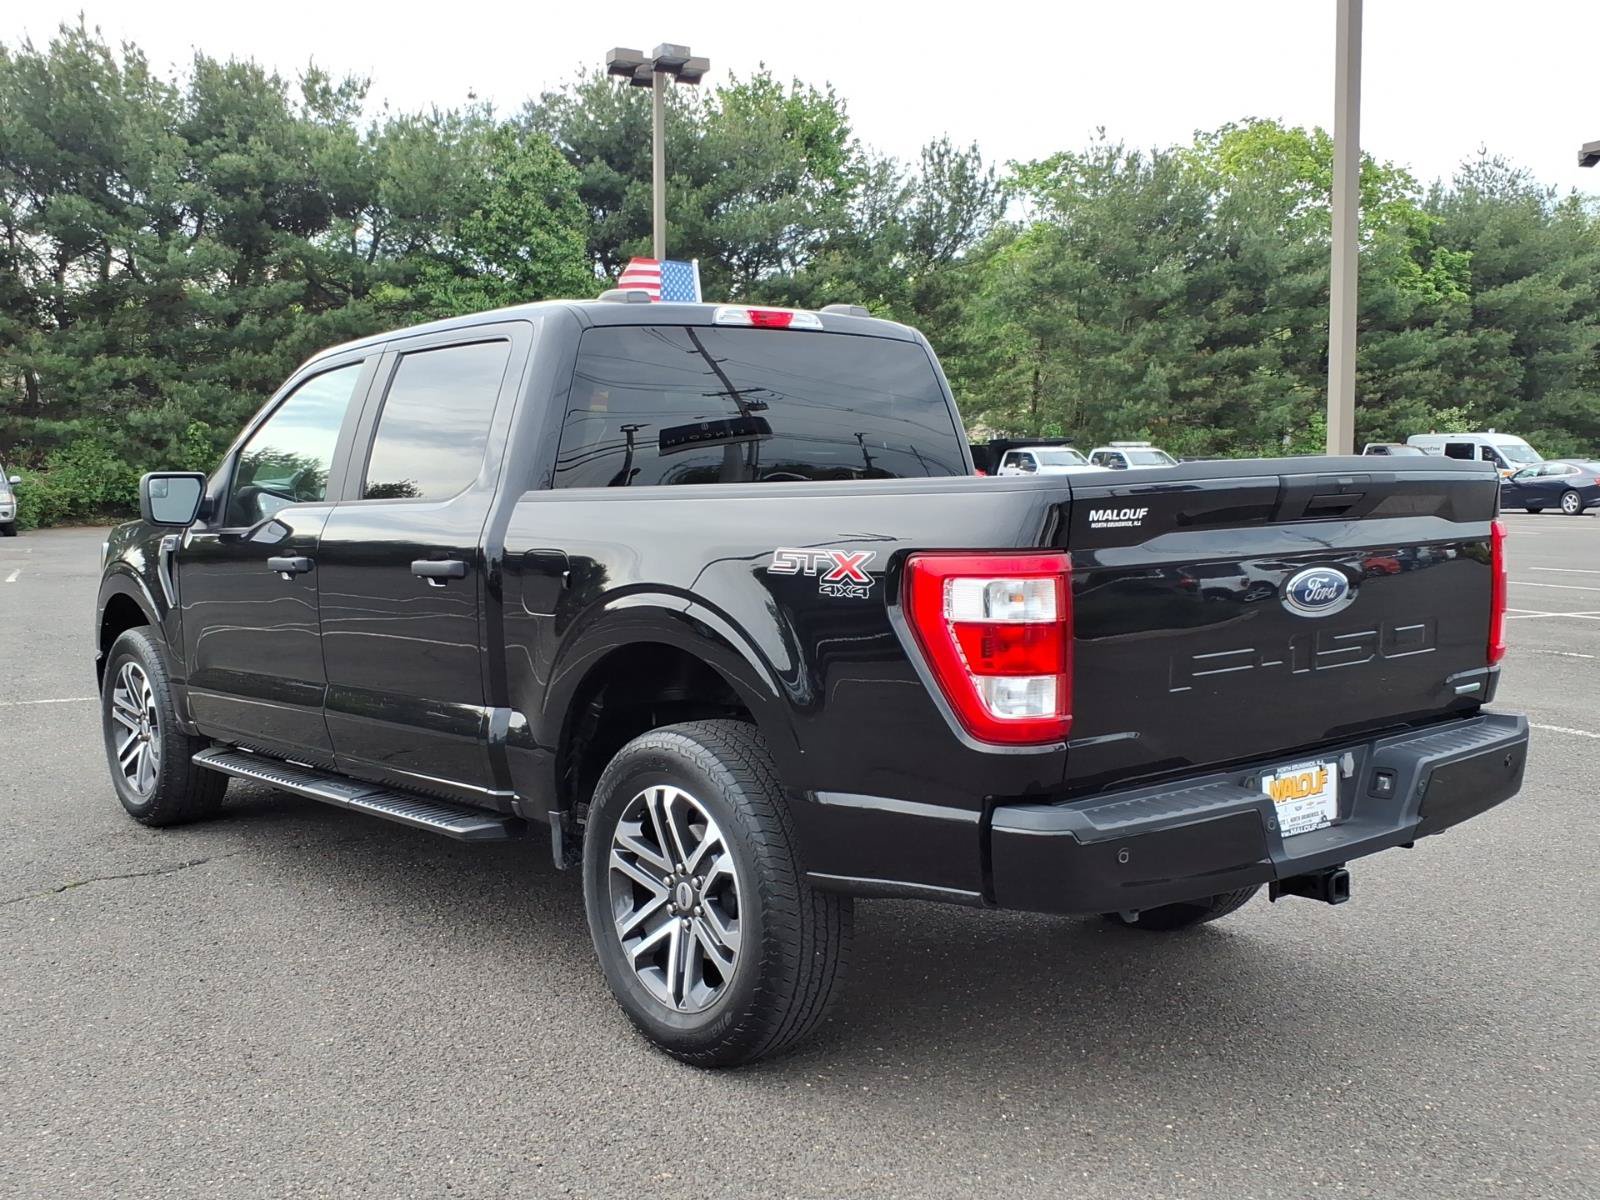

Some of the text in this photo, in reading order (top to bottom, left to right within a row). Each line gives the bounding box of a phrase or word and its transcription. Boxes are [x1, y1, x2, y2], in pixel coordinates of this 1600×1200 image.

[1089, 508, 1148, 521] MALOUF
[767, 547, 876, 585] STX
[1304, 577, 1338, 602] Ford
[1168, 617, 1438, 693] F-150
[1270, 770, 1328, 803] MALOUF
